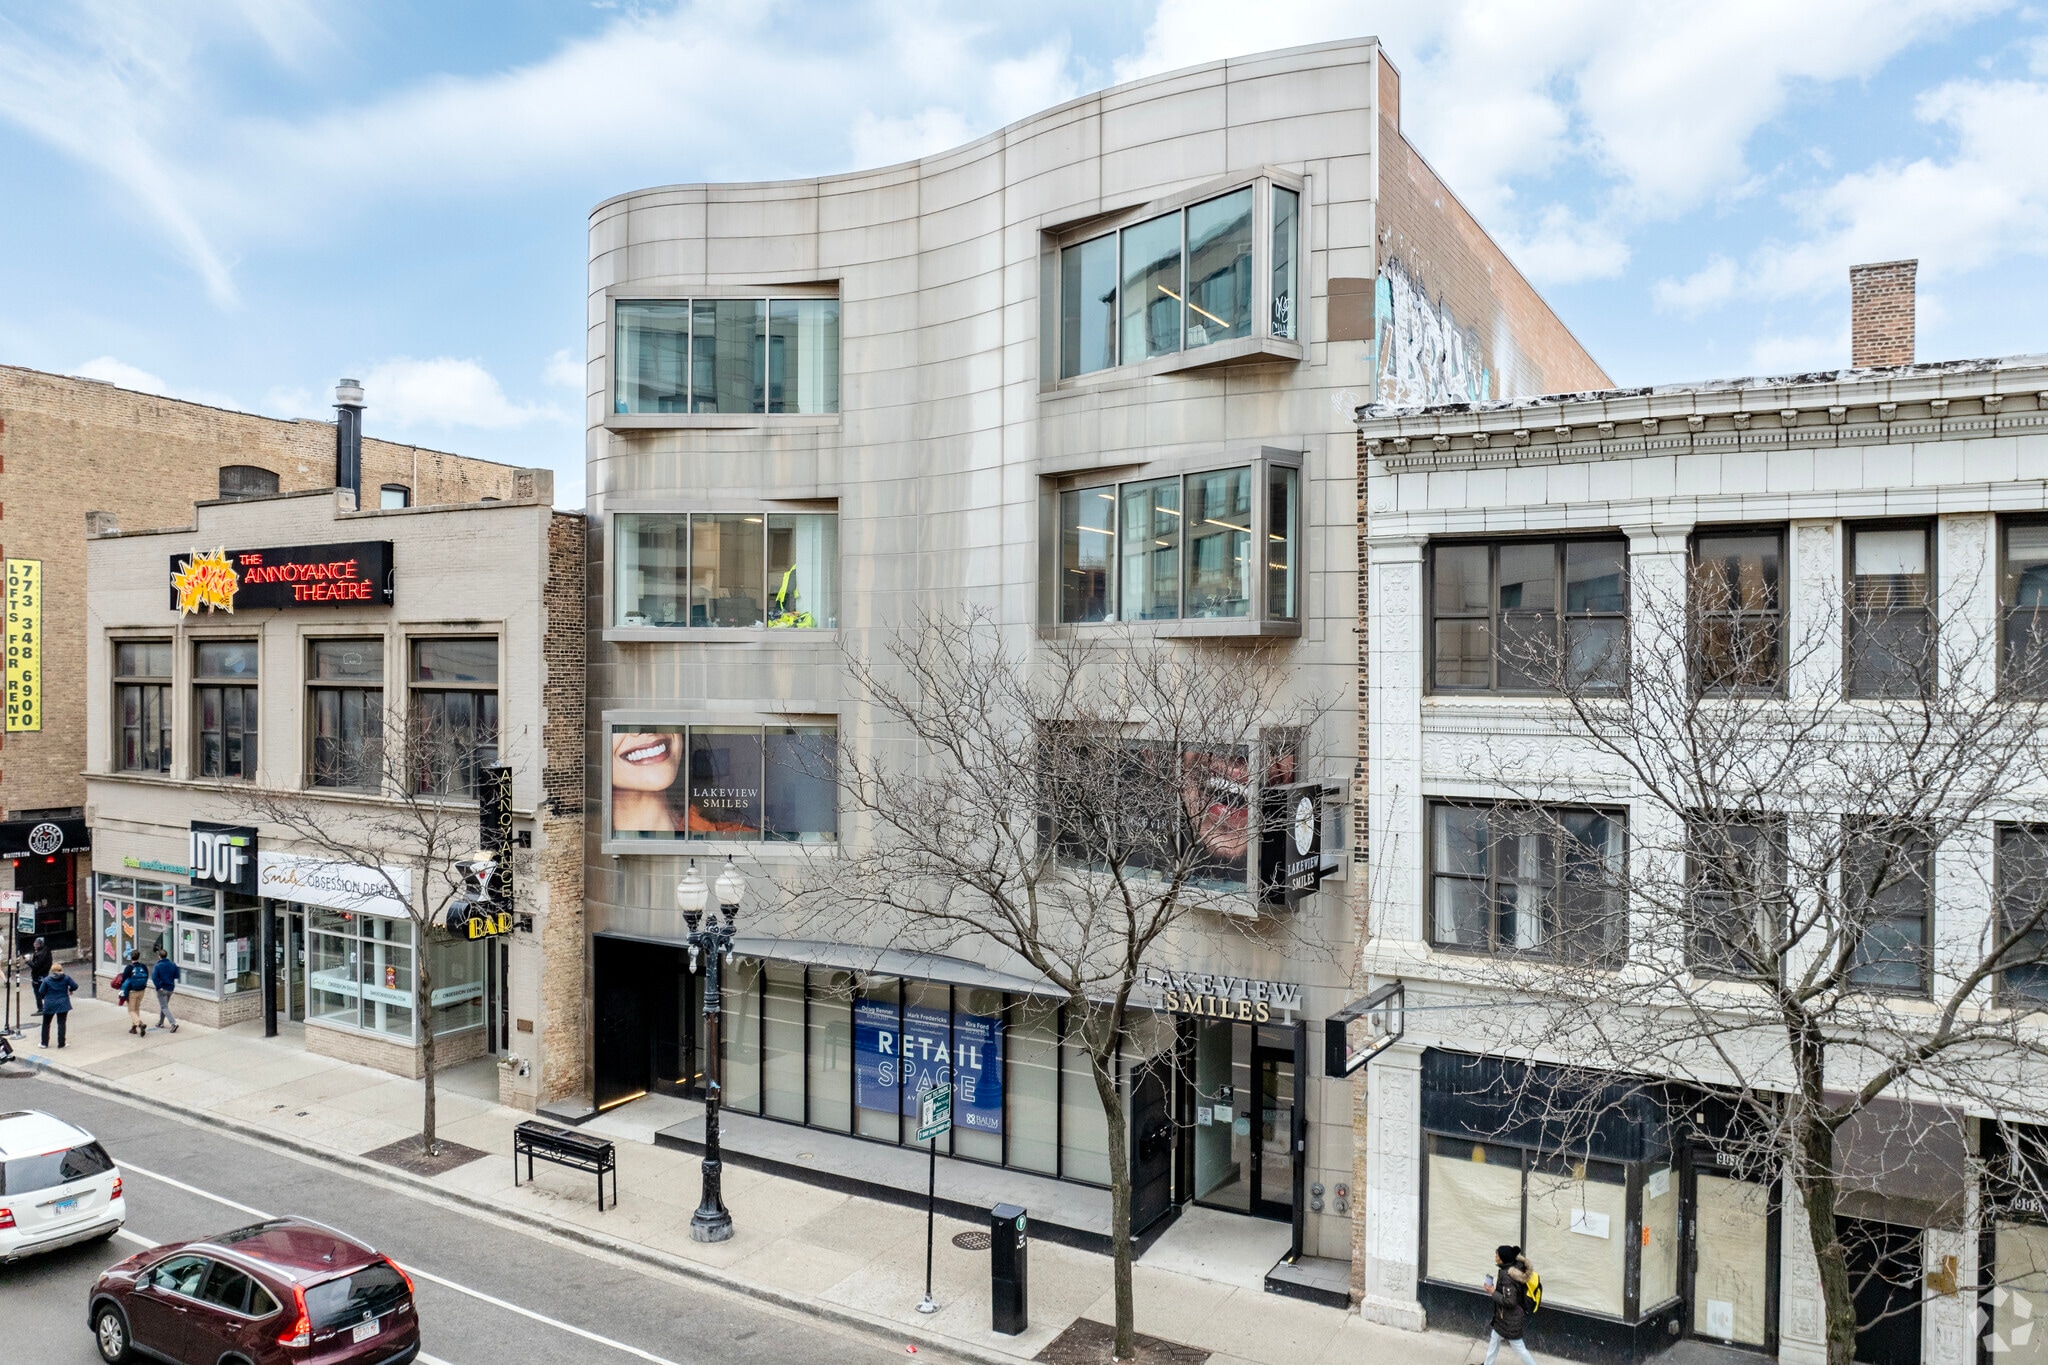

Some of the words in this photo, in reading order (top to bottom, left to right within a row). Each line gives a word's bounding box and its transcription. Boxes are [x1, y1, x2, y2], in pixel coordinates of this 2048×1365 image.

[239, 554, 263, 566] THE
[244, 559, 359, 584] ANNOYANCE
[8, 564, 19, 623] LOFTS
[22, 565, 33, 607] 773
[292, 579, 373, 601] THEATRE
[8, 635, 19, 669] FOR
[22, 617, 33, 660] 348
[8, 681, 19, 726] RENT
[22, 670, 33, 726] 6900
[693, 788, 759, 797] LAKEVIEW
[703, 799, 749, 808] SMILES
[500, 769, 513, 898] ANNOYANCE
[1287, 855, 1319, 877] LAKEVIEW
[262, 866, 305, 887] Smile
[307, 875, 361, 893] OBSESSION
[364, 882, 403, 900] DENTA
[1292, 872, 1315, 890] SMILES
[469, 911, 513, 940] BAR
[1138, 967, 1300, 1004] LAKEVIEW
[875, 1007, 894, 1016] Renner
[921, 1013, 948, 1024] Fredericks
[1167, 990, 1271, 1023] SMILES
[976, 1022, 989, 1030] Ford
[878, 1031, 982, 1070] RETAIL
[878, 1059, 976, 1103] SPACE
[976, 1115, 999, 1129] BAUM
[2016, 1198, 2040, 1211] 903
